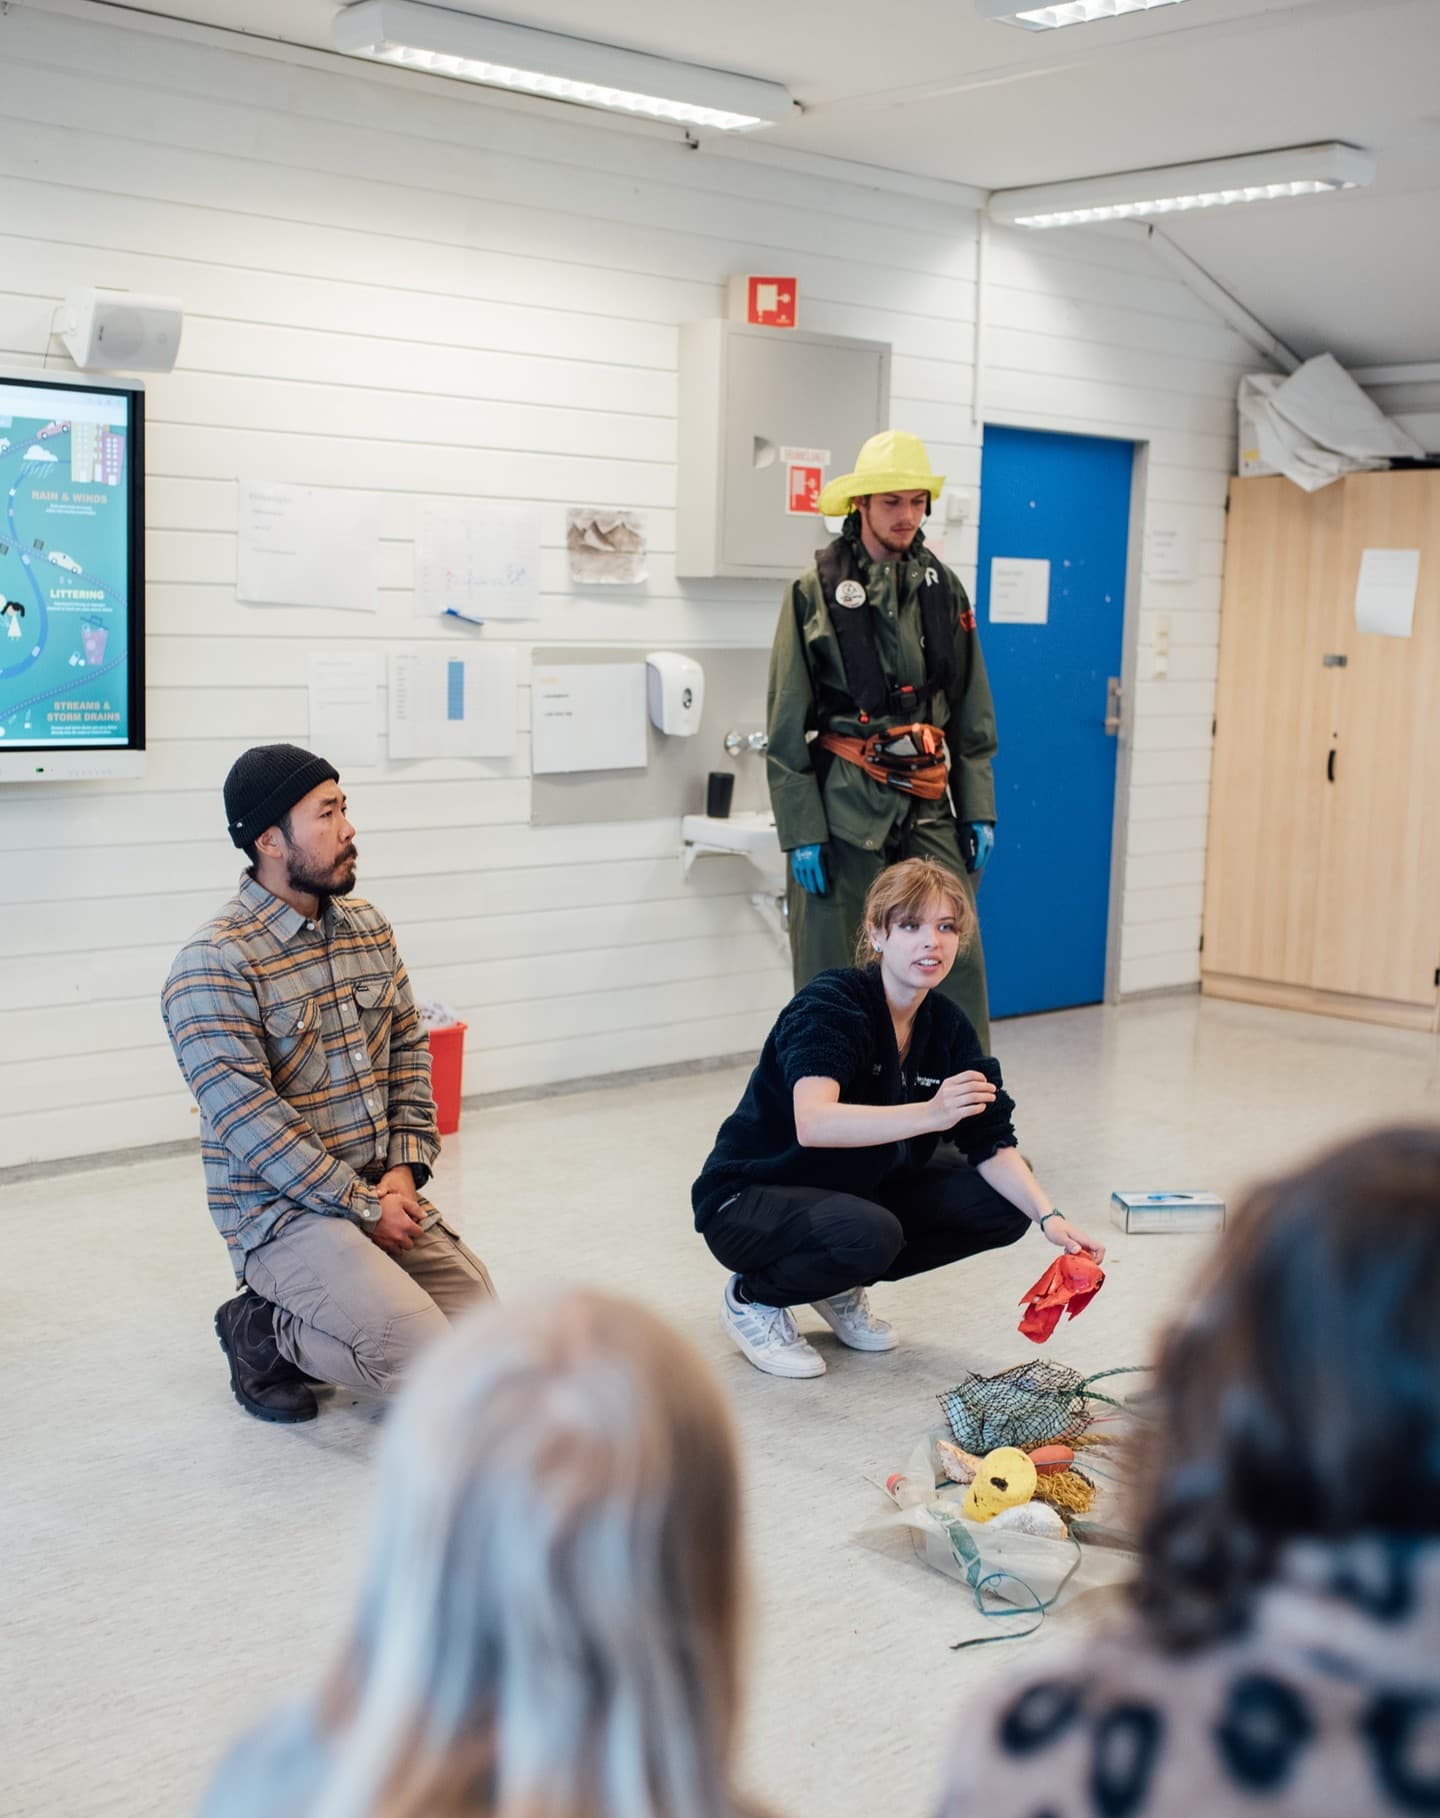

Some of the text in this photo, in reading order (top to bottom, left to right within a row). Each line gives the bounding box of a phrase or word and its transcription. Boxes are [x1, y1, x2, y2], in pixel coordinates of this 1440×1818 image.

[32, 490, 58, 501] RAIN
[50, 589, 104, 600] LITTERING
[54, 701, 100, 711] STREAMS
[47, 712, 120, 722] STORM DRAINS
